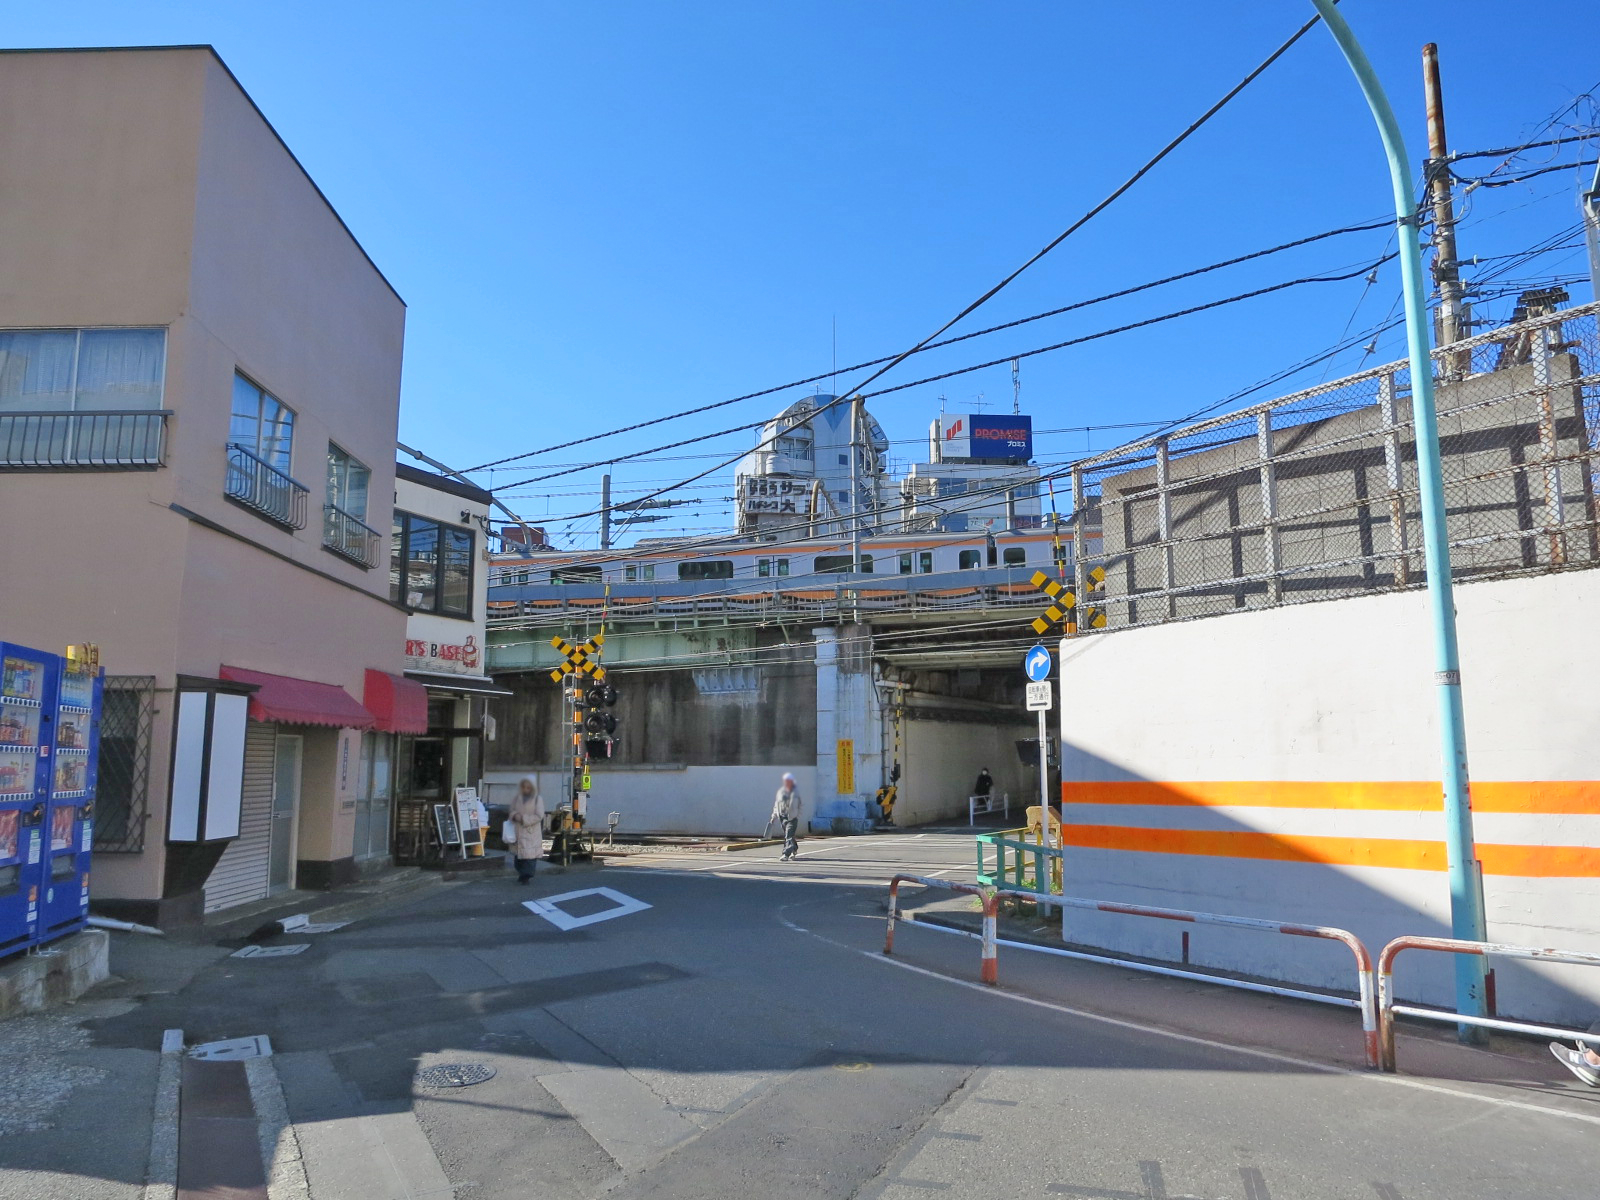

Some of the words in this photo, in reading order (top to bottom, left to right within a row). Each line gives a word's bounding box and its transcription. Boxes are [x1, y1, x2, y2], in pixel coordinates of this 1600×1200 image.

[975, 428, 1027, 441] PROMISE
[1006, 440, 1027, 448] プロミス
